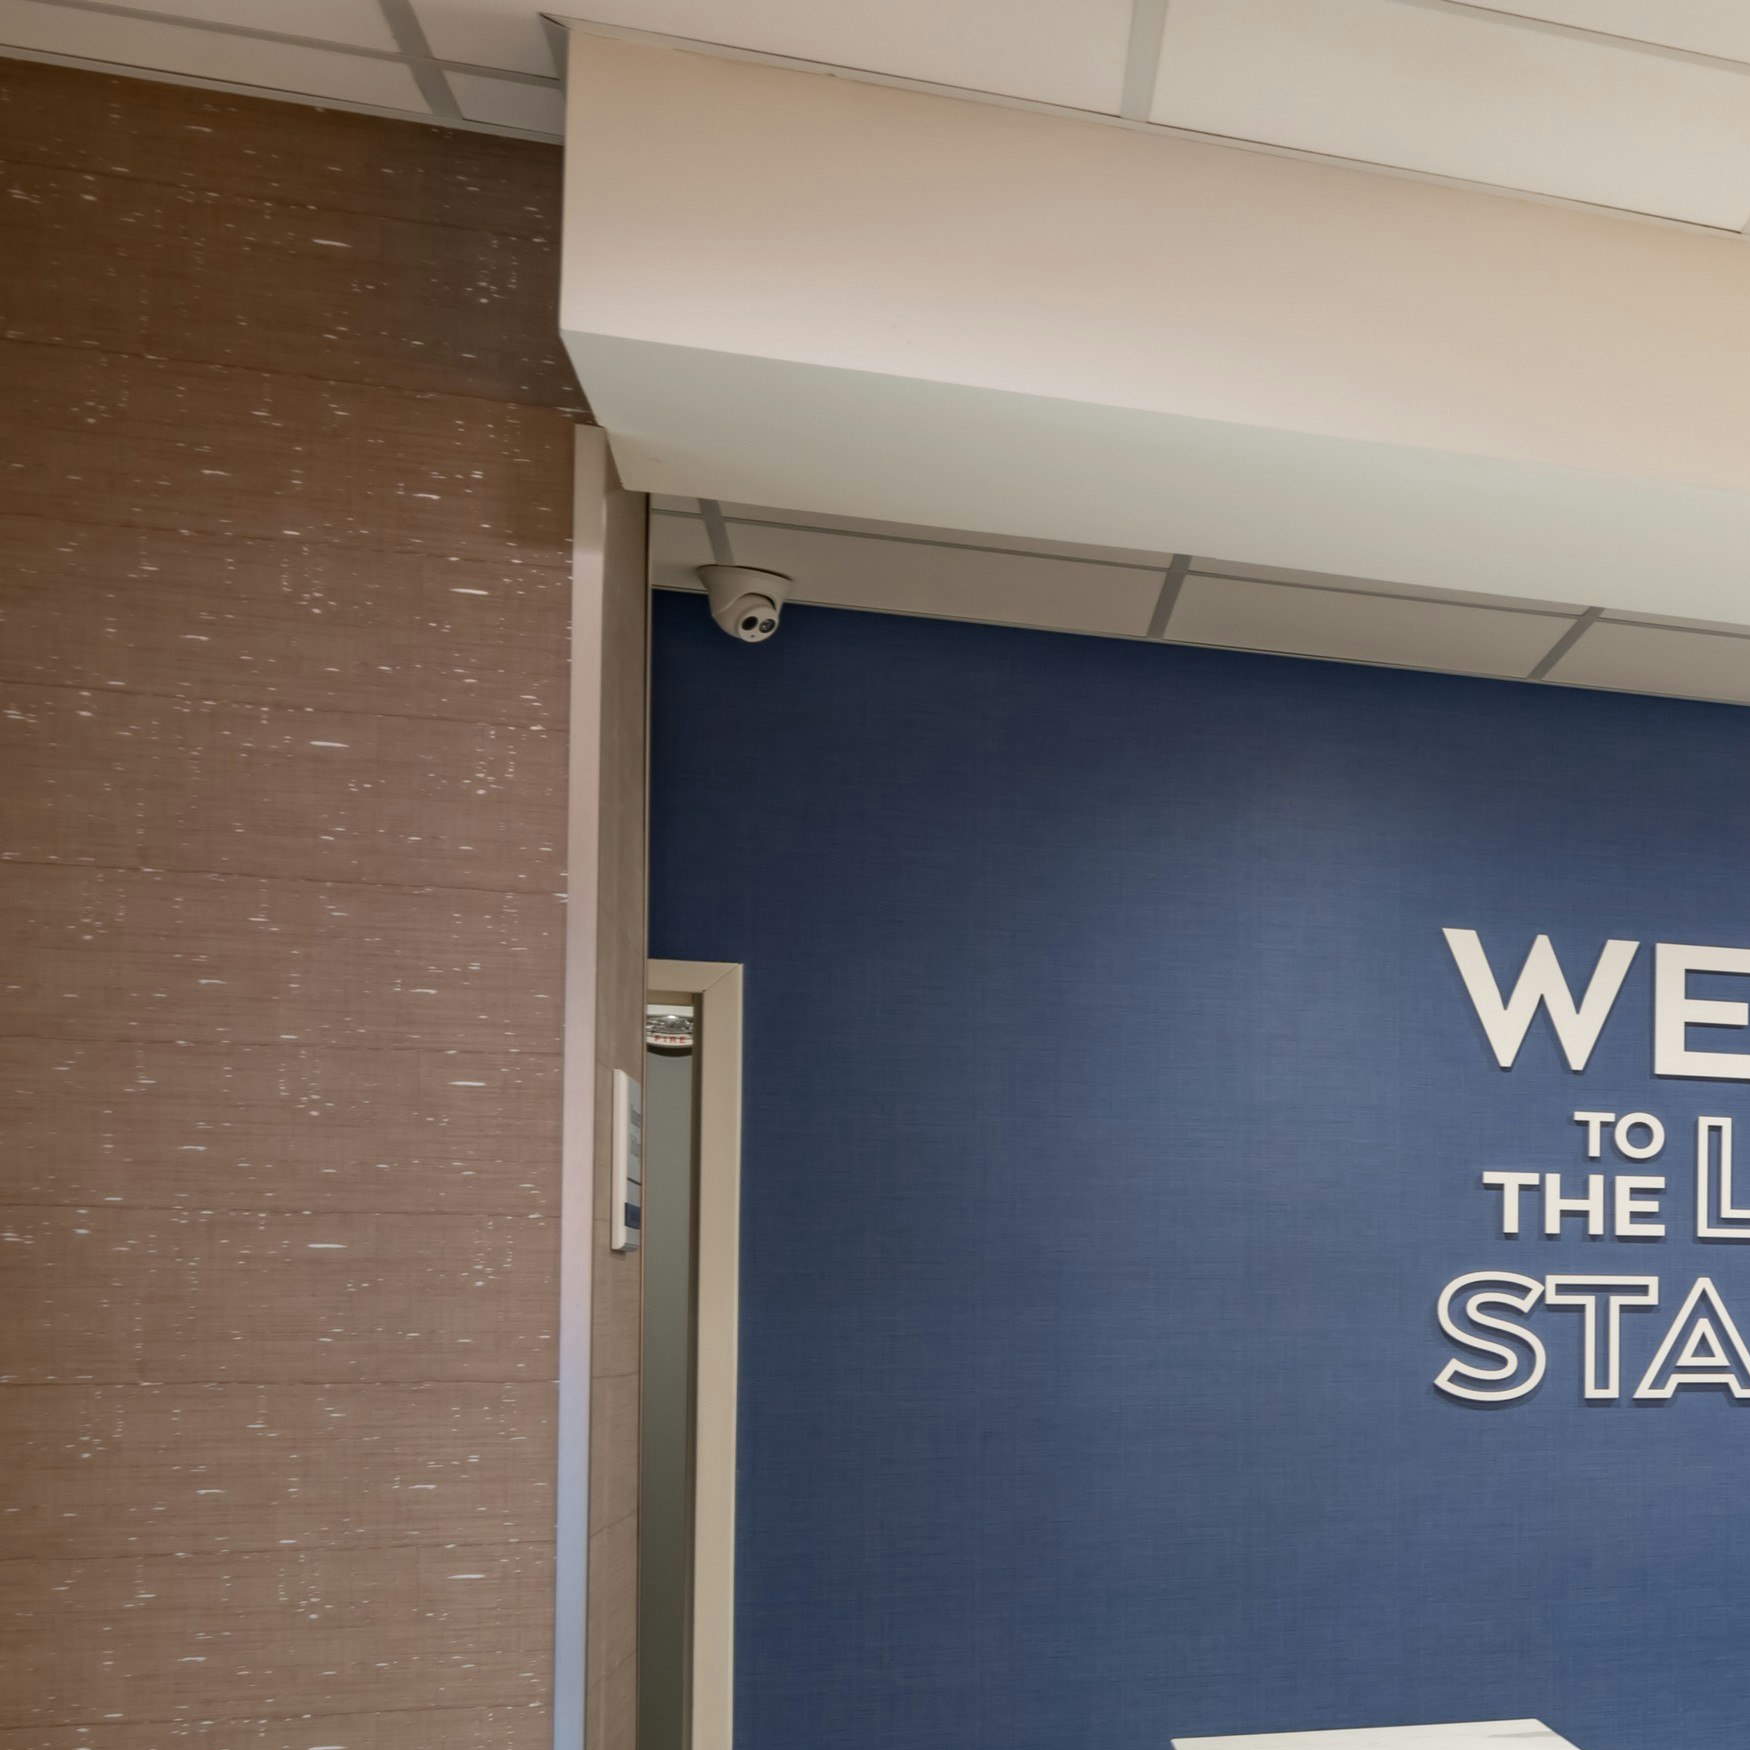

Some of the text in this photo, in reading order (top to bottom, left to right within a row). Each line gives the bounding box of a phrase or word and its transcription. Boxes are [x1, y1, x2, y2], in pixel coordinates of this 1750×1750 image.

[654, 1035, 686, 1044] FIRE
[1573, 1111, 1666, 1158] TO
[1482, 1171, 1666, 1237] THE
